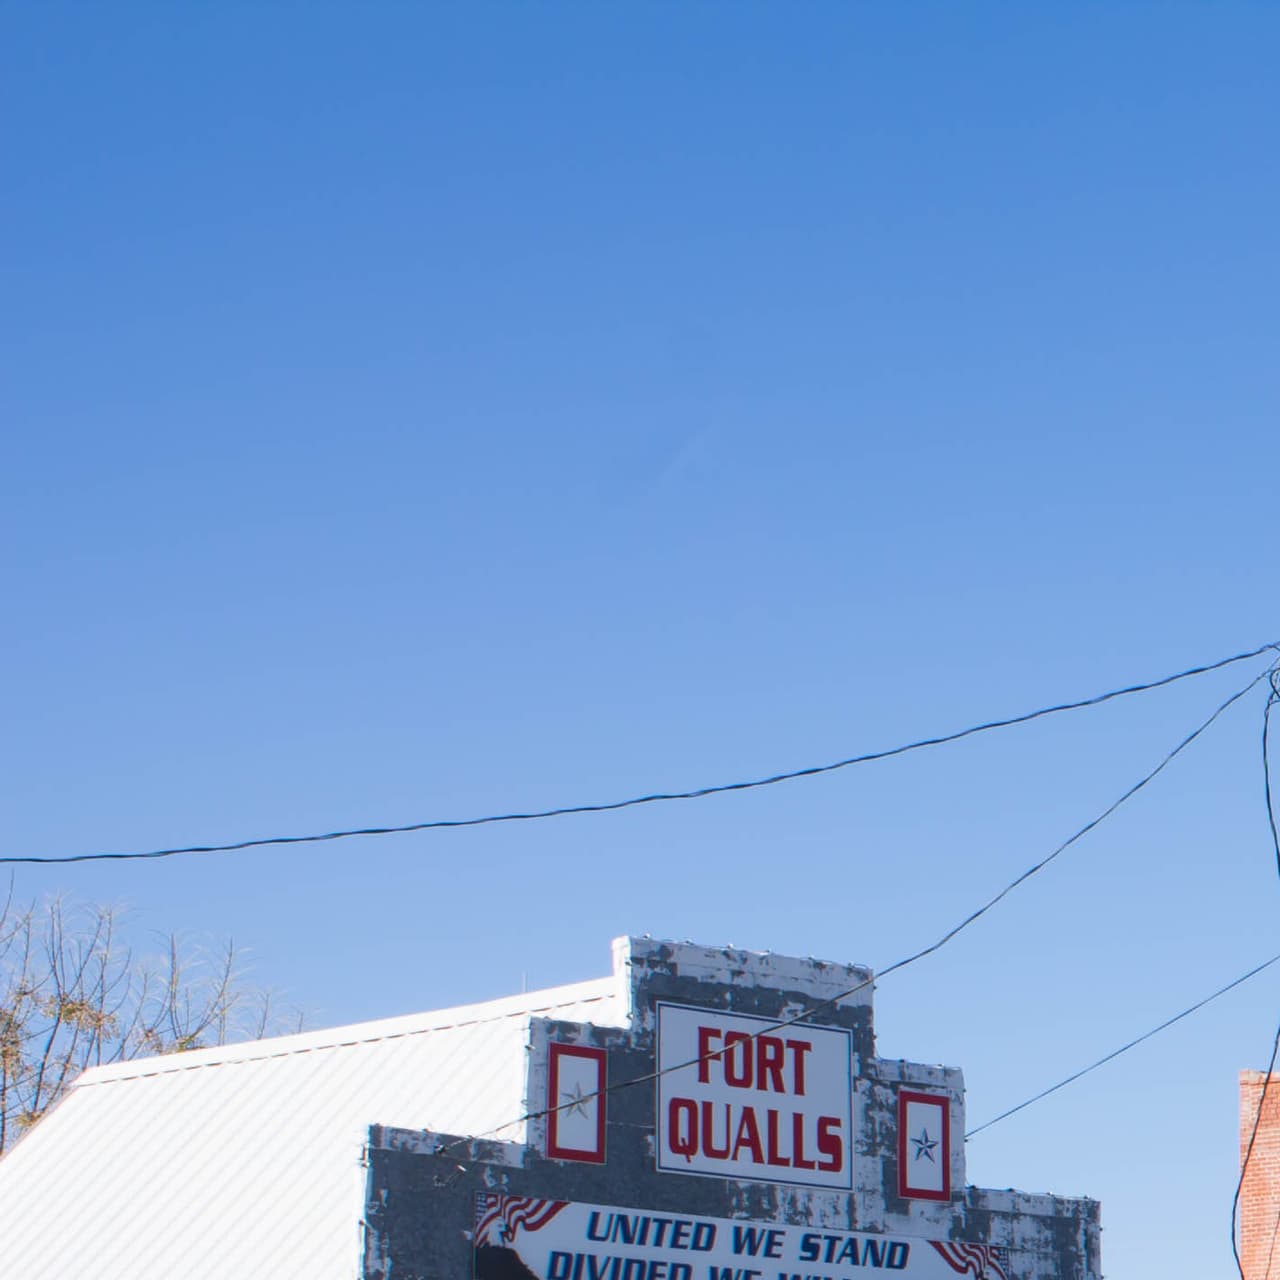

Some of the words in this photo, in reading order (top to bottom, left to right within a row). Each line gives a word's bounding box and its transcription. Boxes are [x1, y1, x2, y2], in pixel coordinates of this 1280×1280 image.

[697, 1026, 812, 1096] FORT
[668, 1097, 843, 1173] QUALLS
[586, 1211, 718, 1252] UNITED
[732, 1225, 786, 1259] WE
[798, 1233, 911, 1270] STAND
